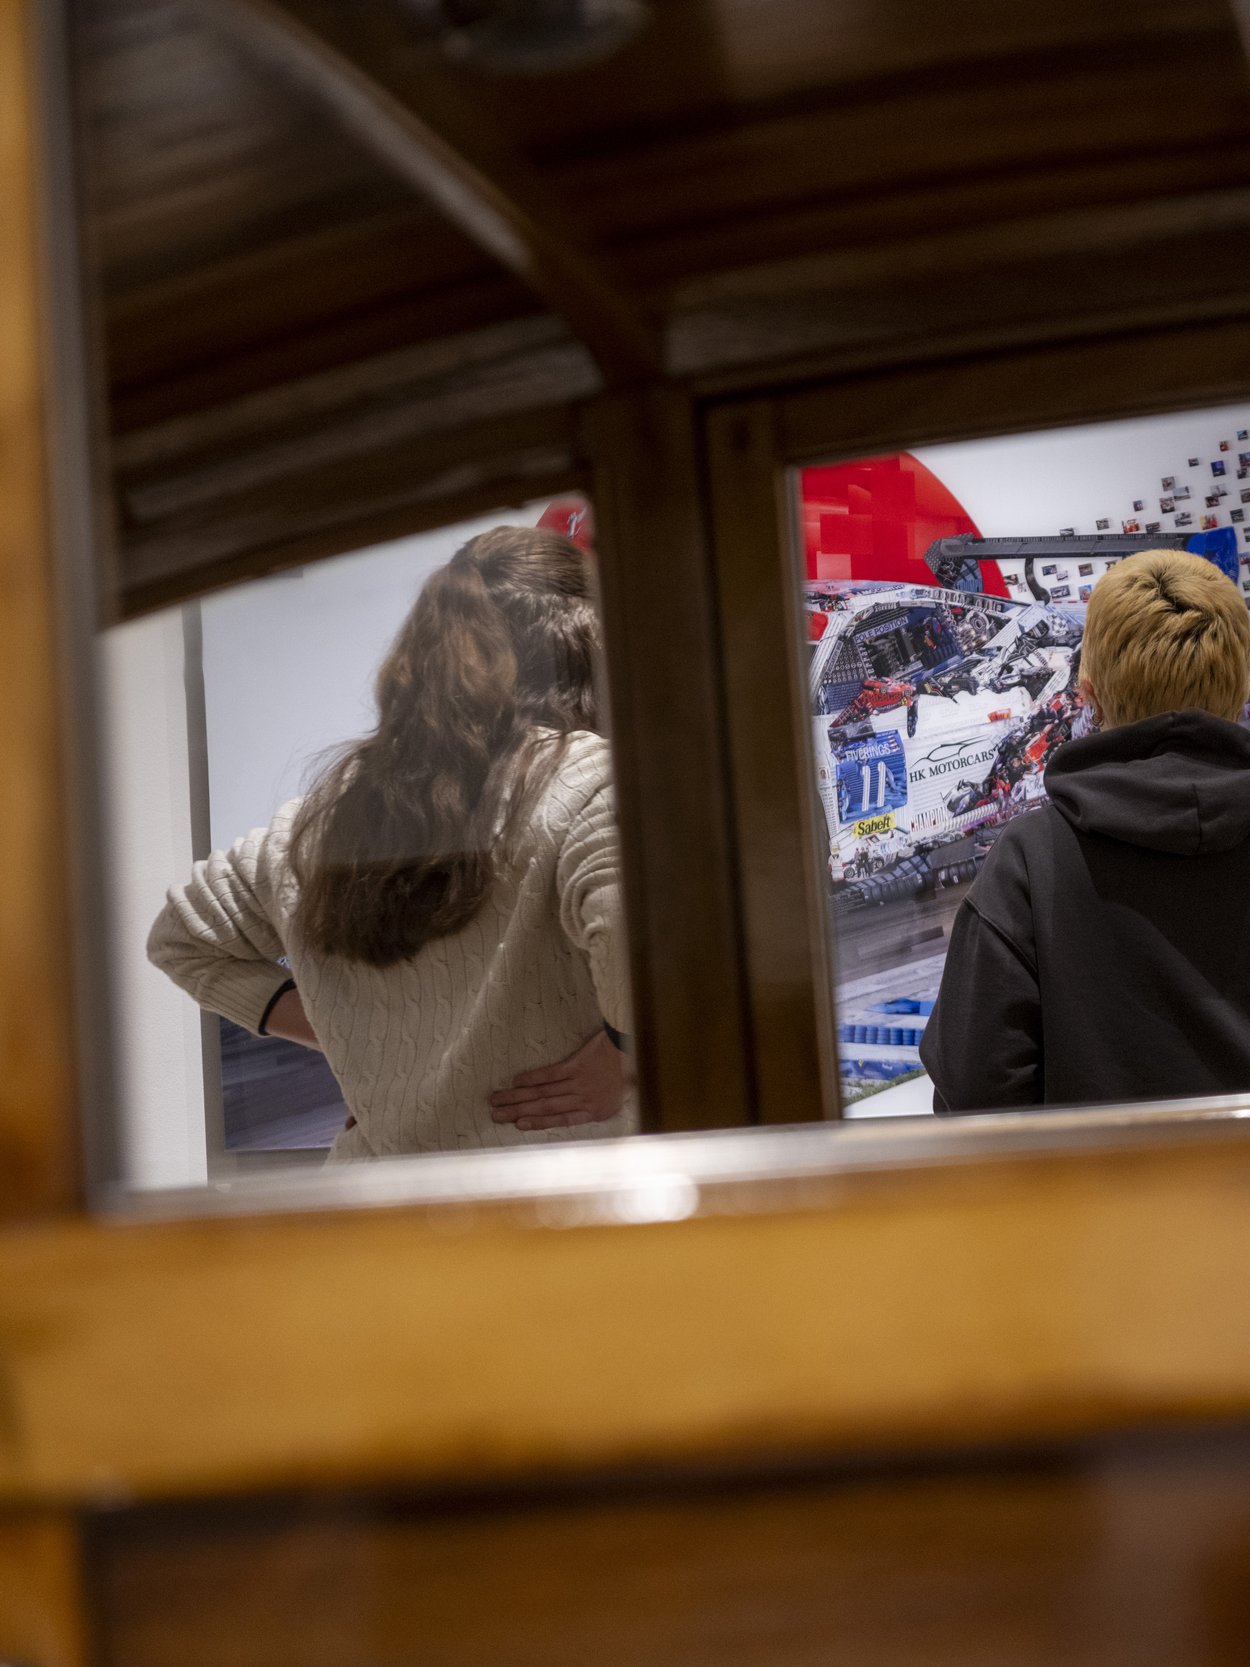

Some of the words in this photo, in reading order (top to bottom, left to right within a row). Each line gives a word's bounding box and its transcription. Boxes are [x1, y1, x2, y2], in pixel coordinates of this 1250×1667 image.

[854, 629, 873, 644] POLE
[874, 616, 909, 636] POSITION
[909, 768, 926, 783] HK
[929, 750, 995, 777] MOTORCARS
[860, 761, 886, 812] 11
[858, 815, 891, 835] Sabelt
